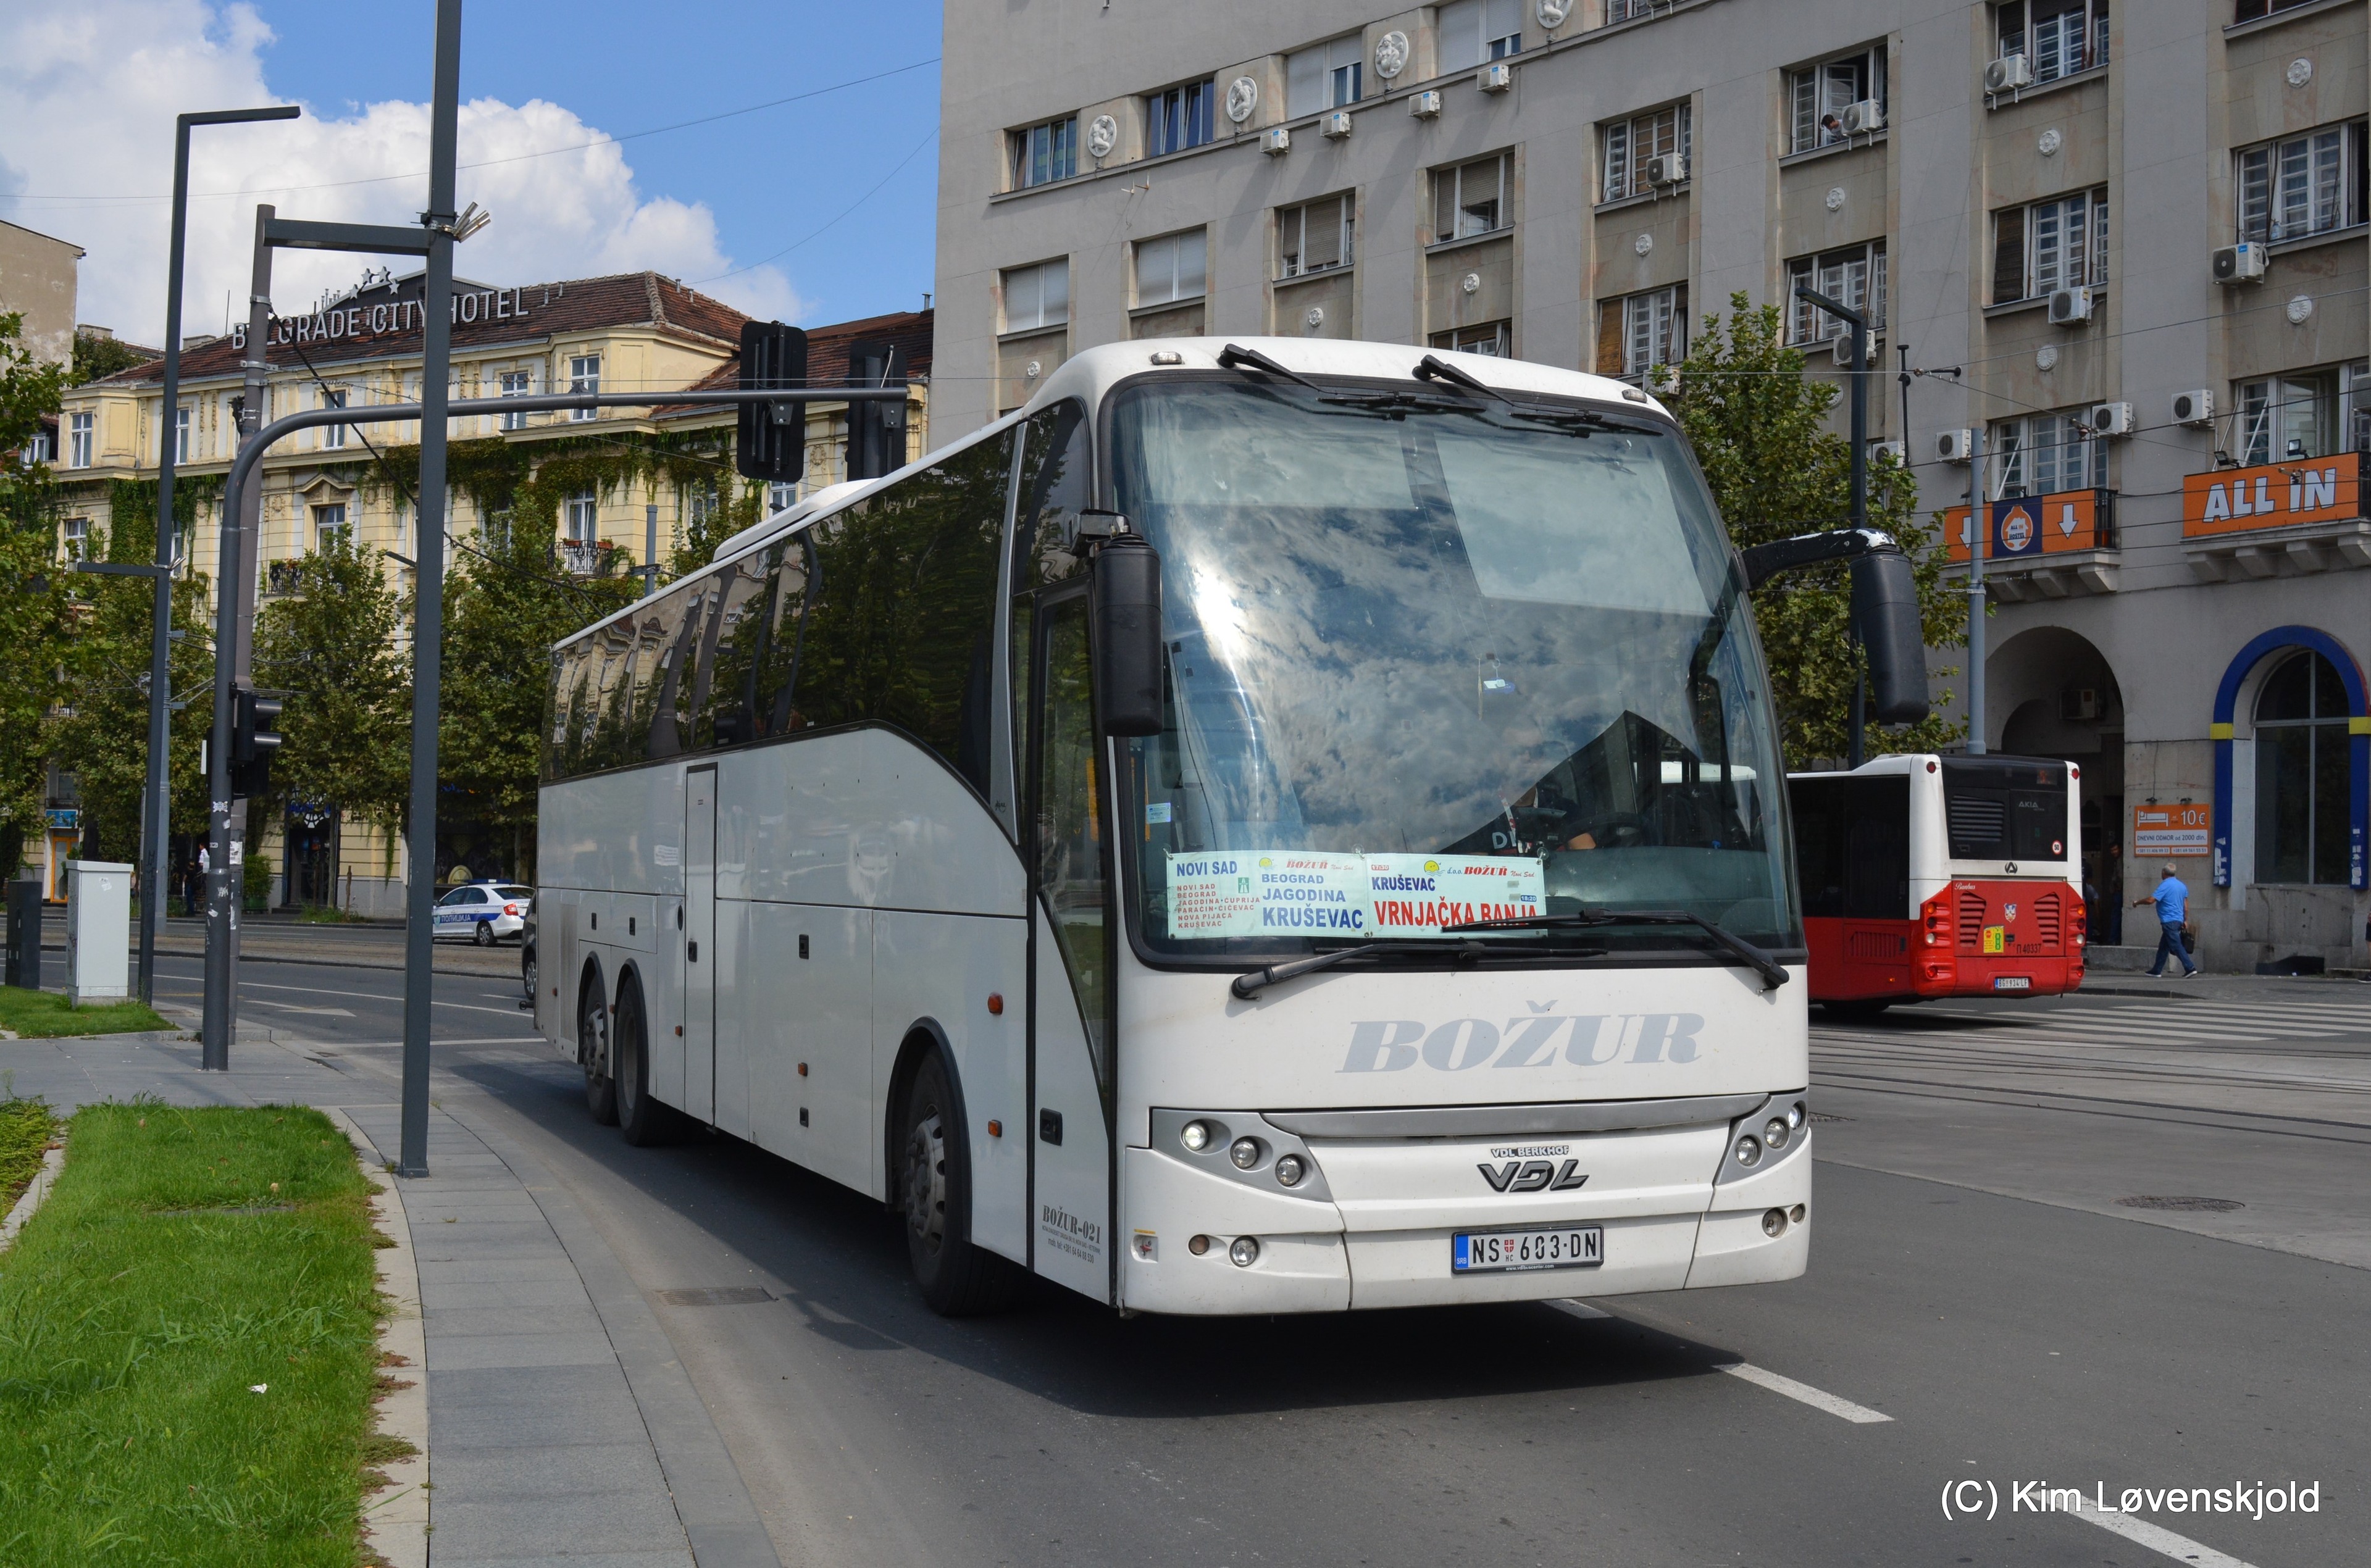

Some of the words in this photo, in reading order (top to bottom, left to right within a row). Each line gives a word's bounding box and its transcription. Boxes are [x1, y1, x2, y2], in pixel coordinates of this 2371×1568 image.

[233, 307, 361, 349] BGRADE
[2202, 476, 2275, 523] ALL
[2289, 467, 2336, 513] IN
[2181, 810, 2196, 825] 10
[2199, 812, 2206, 825] €
[1176, 862, 1207, 877] NOVI
[1212, 861, 1237, 875] SAD
[1286, 859, 1328, 869] BOŽUR
[1447, 867, 1463, 875] d.o.o.
[1464, 865, 1508, 876] BOŽUR
[1261, 874, 1324, 884] BEOGRAD
[1371, 874, 1436, 891] KRUŠEVAC
[1263, 888, 1346, 902] JAGODINA
[441, 914, 471, 922] ПОЛИЦИЈА
[1263, 903, 1363, 929] KRUŠEVAC
[1374, 896, 1475, 927] VRNJAČKA
[1178, 920, 1222, 928] KRUŠEVAC
[2023, 943, 2042, 954] 40337
[1999, 979, 2005, 987] BG
[1334, 999, 1705, 1074] BOŽUR
[1491, 1148, 1515, 1157] VDL
[1517, 1145, 1570, 1157] BERKHOF
[1476, 1159, 1590, 1193] VDL
[1042, 1205, 1100, 1245] BOŽUR-021
[1473, 1238, 1500, 1264] NS
